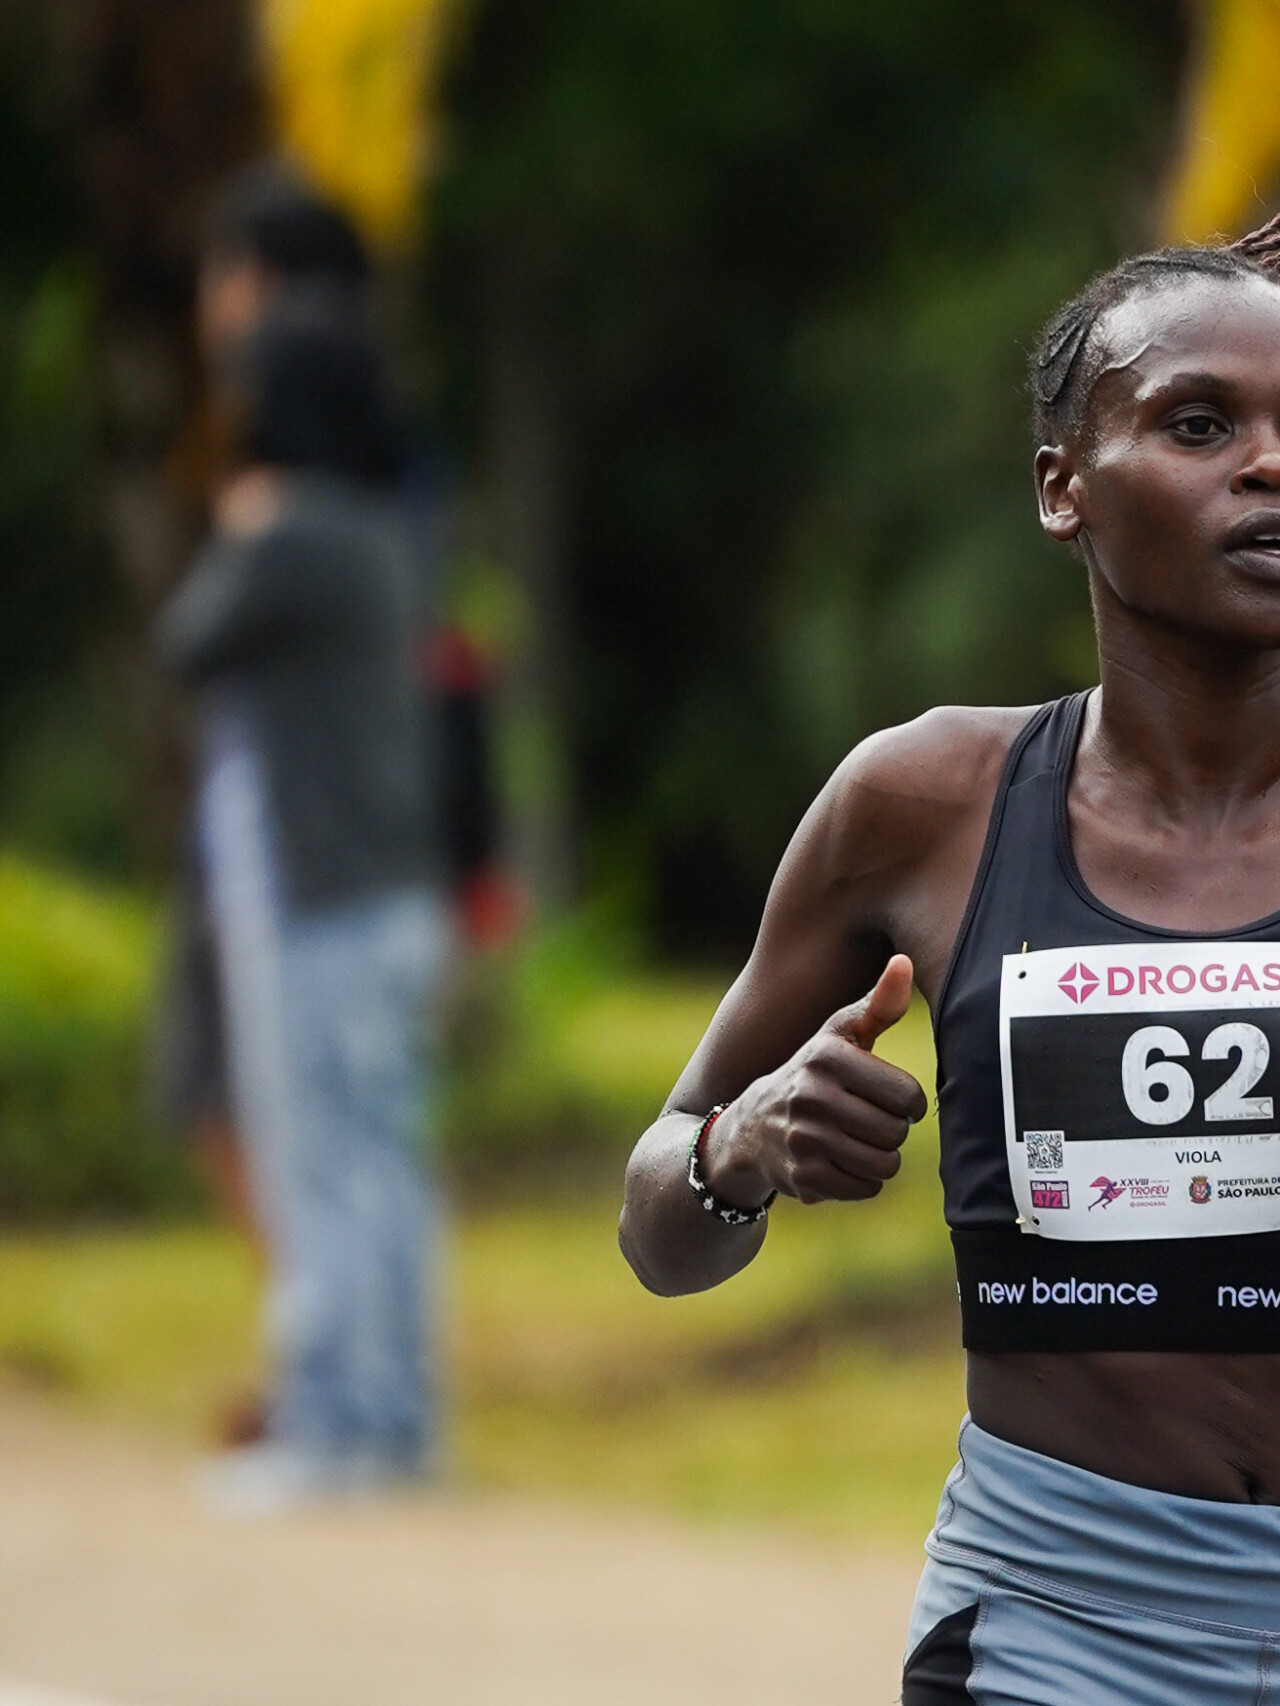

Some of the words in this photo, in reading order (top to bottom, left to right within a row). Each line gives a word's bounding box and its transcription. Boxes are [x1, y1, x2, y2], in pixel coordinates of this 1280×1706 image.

[1121, 1022, 1274, 1126] 62
[1174, 1150, 1222, 1164] VIOLA
[1217, 1177, 1269, 1187] PREFEITURA
[1129, 1184, 1170, 1196] TROFÉU
[1217, 1186, 1242, 1199] SÃO
[1032, 1191, 1062, 1208] 472
[978, 1282, 1026, 1304] new
[1032, 1276, 1158, 1305] balance
